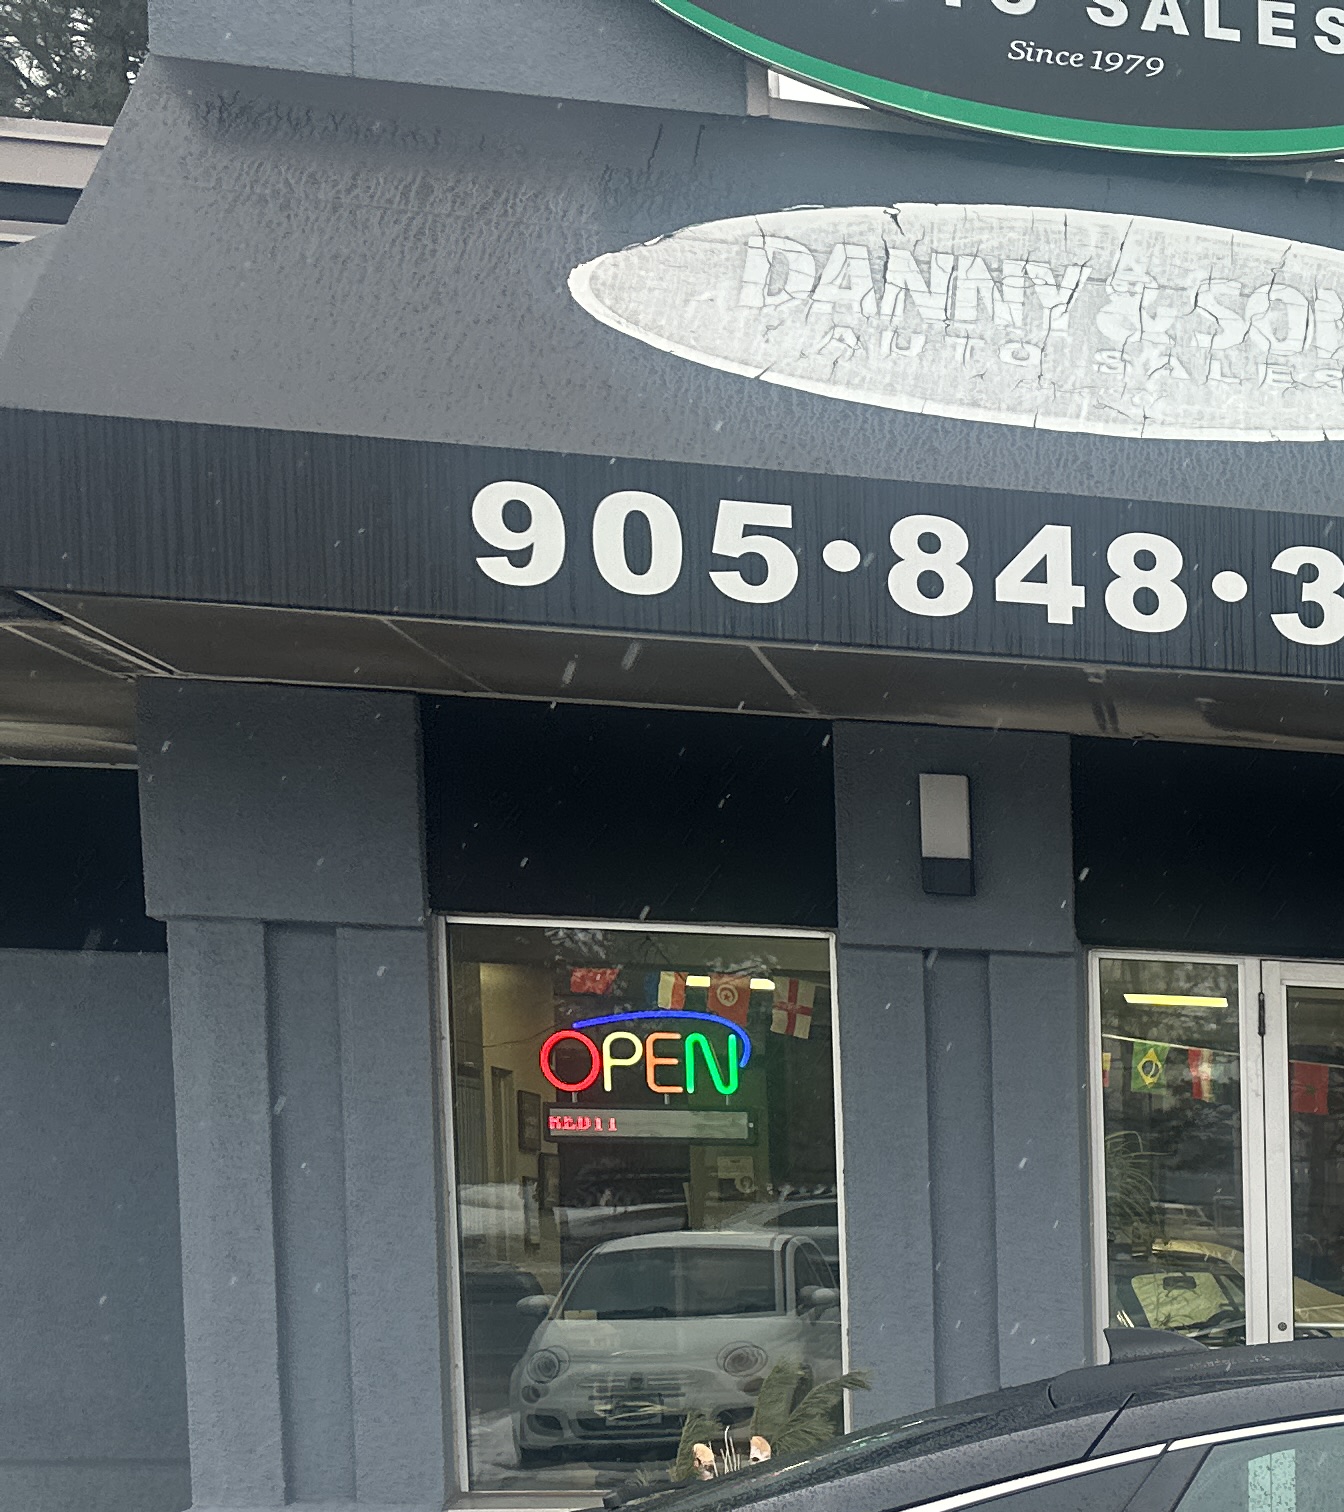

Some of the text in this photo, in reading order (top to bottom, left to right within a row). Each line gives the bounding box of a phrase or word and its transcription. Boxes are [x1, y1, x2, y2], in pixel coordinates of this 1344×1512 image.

[1007, 40, 1165, 78] Since 1979
[738, 235, 1093, 338] DANNY
[539, 1029, 740, 1095] OPEN
